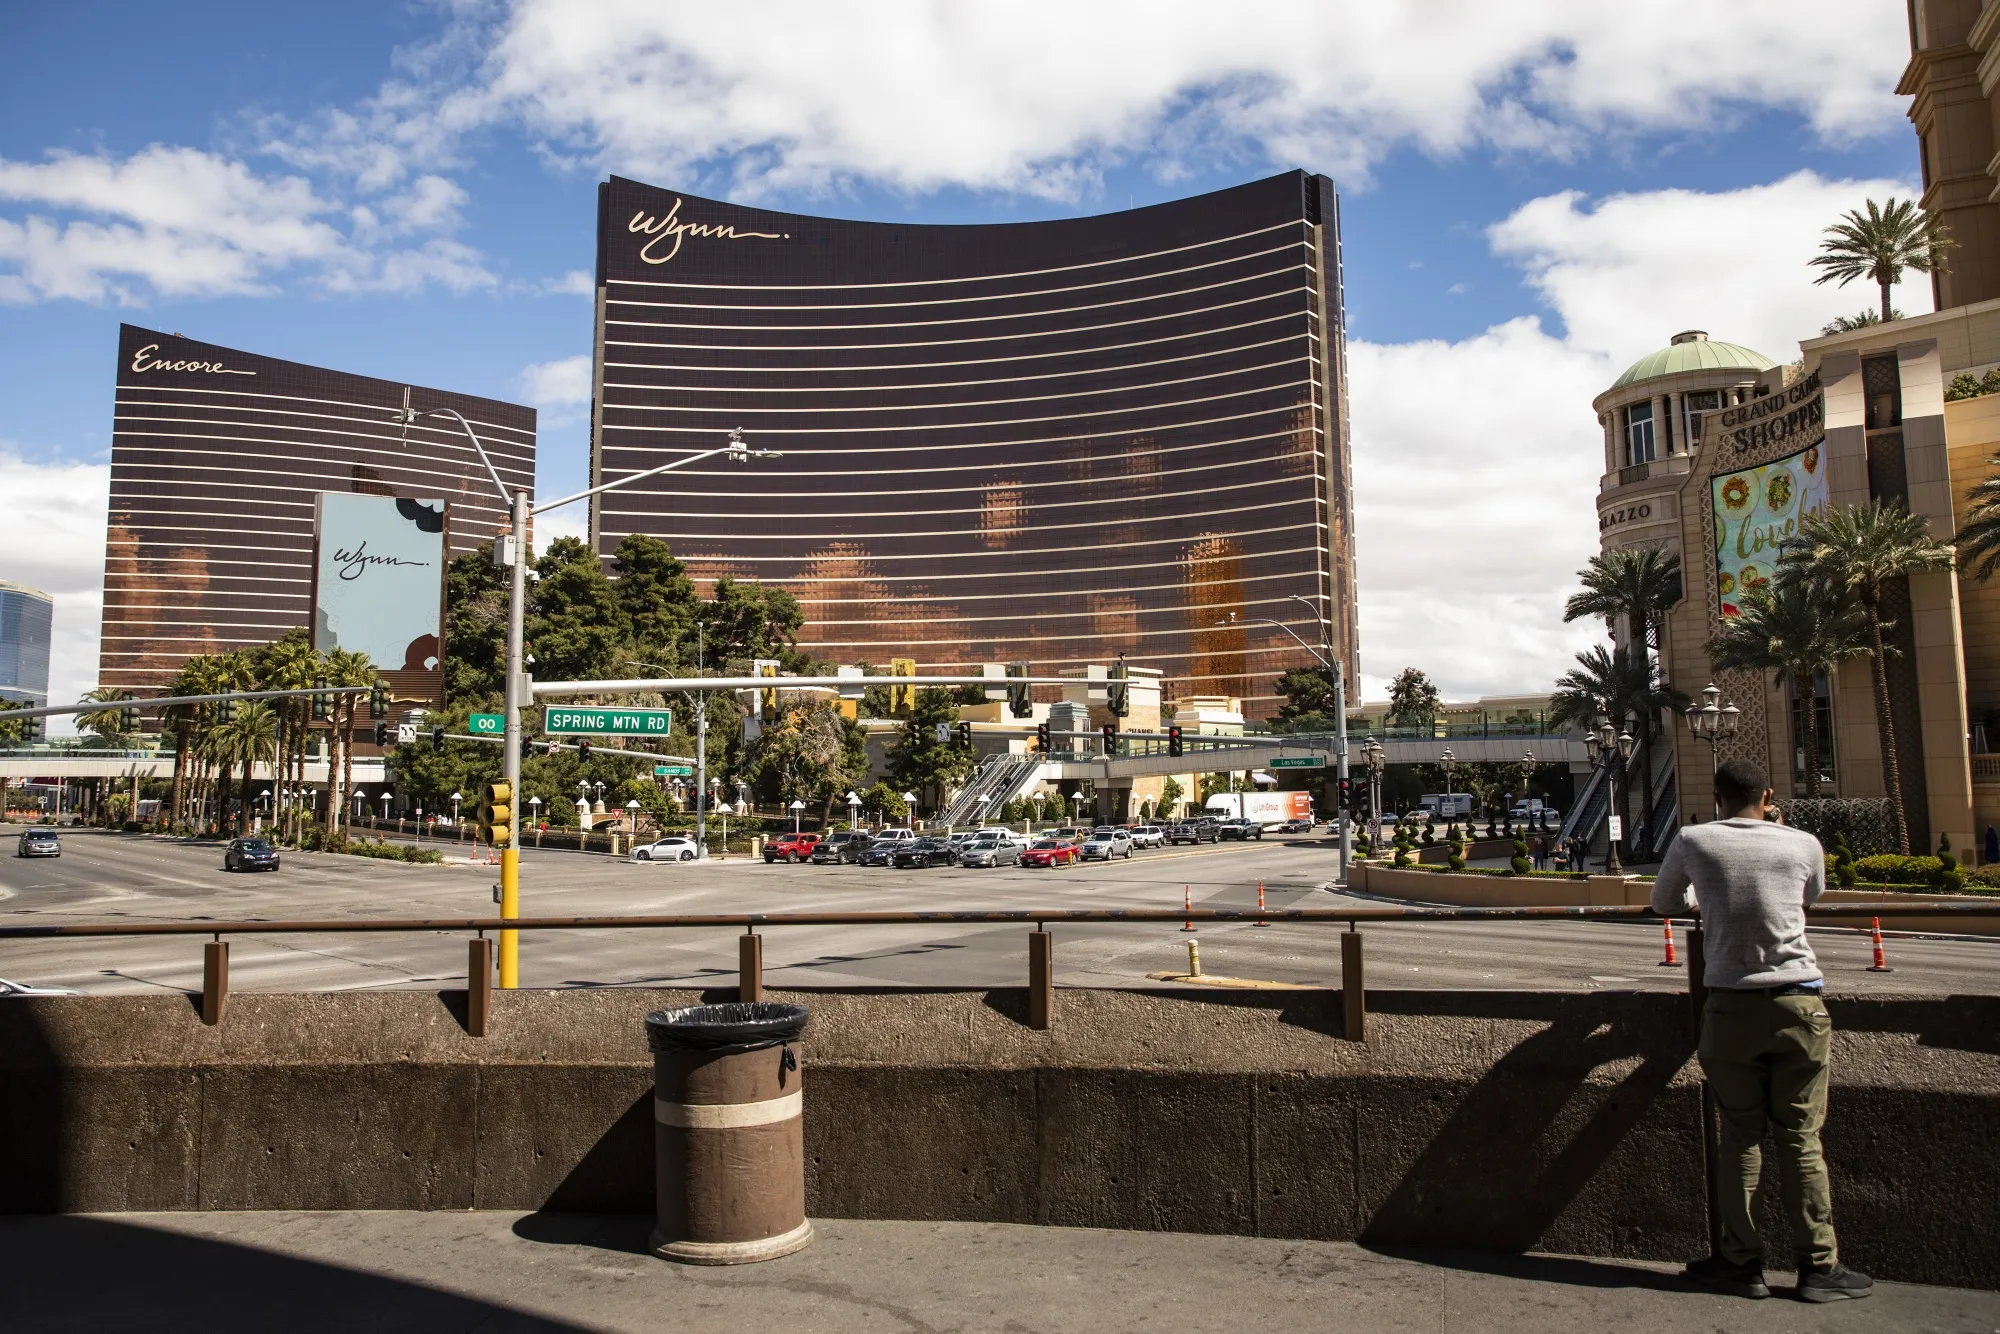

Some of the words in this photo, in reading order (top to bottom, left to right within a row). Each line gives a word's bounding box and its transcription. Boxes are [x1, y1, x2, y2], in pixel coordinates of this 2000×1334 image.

[131, 344, 257, 375] Encore
[1721, 394, 1785, 427] GRAND
[1599, 504, 1651, 532] ALAZZO
[552, 714, 605, 729] SPRING
[612, 717, 640, 729] MTN
[647, 717, 665, 730] RD
